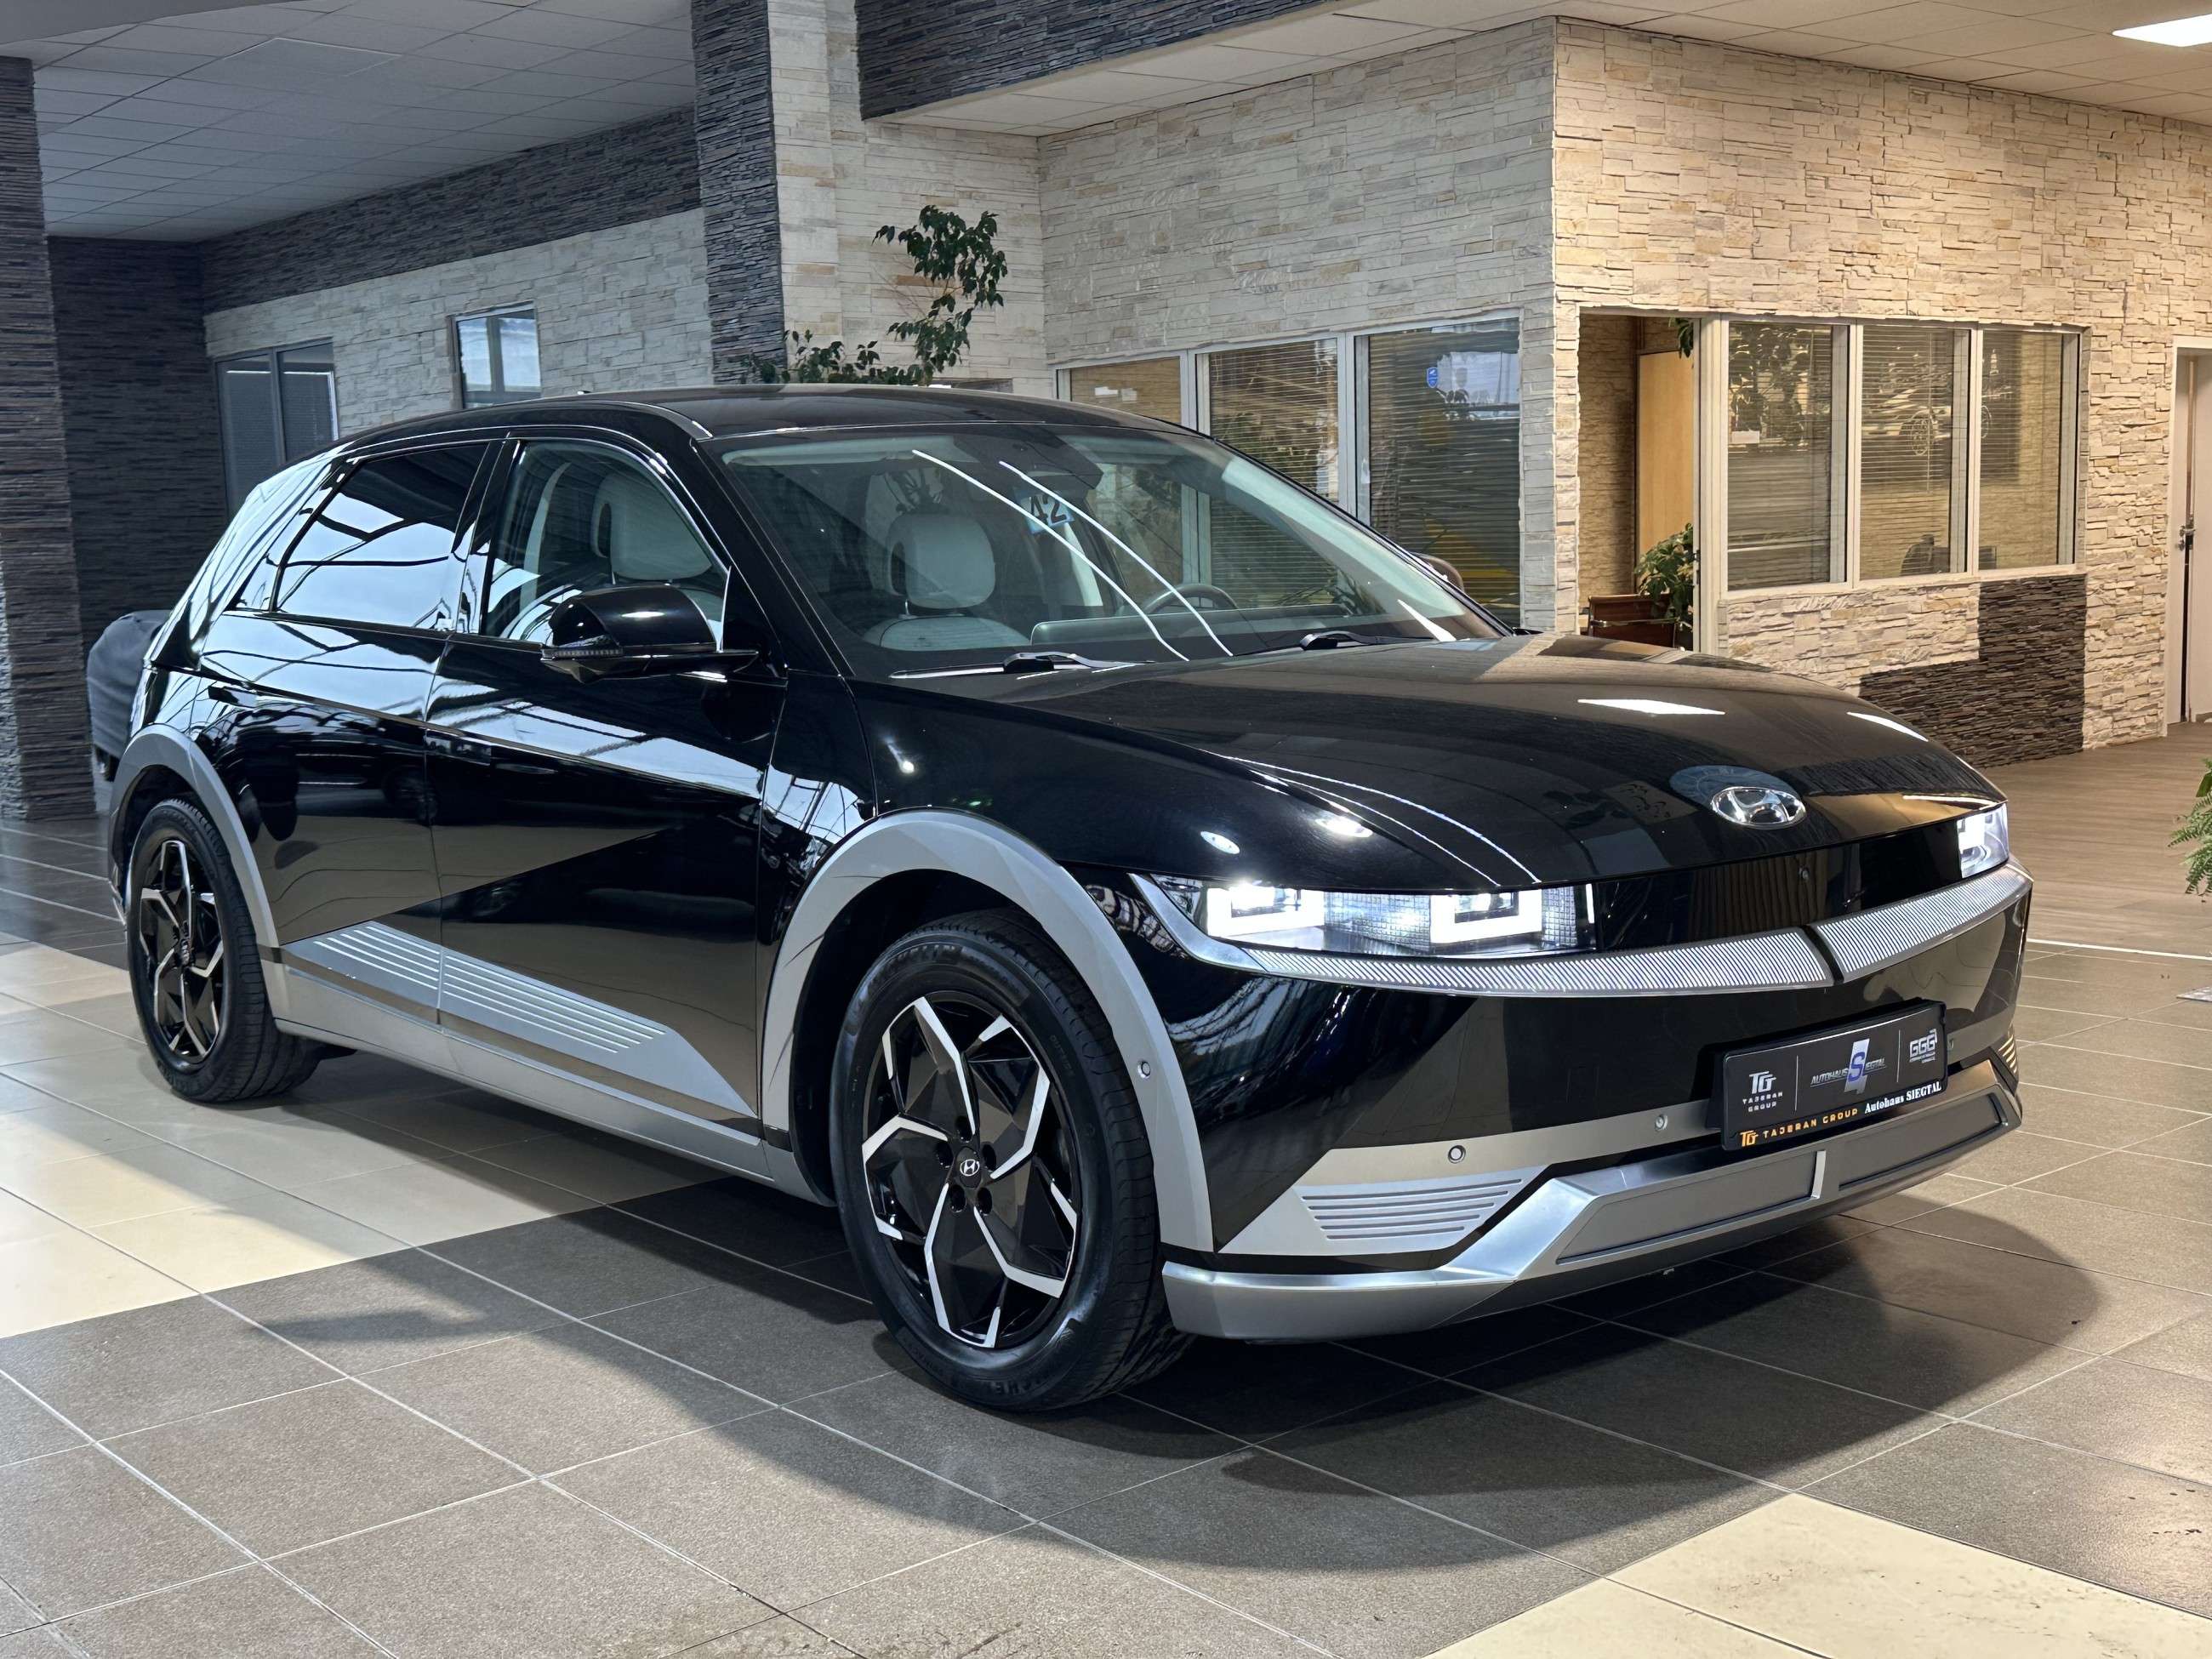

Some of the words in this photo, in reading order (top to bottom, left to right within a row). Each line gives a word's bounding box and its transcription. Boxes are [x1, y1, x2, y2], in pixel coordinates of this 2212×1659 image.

[1909, 1035, 1936, 1058] GGG
[1748, 1070, 1777, 1095] TG
[1810, 1067, 1850, 1086] AUTOHAUS
[1742, 1092, 1783, 1104] TAJERAN
[1747, 1101, 1777, 1113] GROUP
[1763, 1119, 1817, 1138] TAJERAN
[1822, 1108, 1858, 1124] GROUP
[1864, 1095, 1905, 1115] Autohaus
[1906, 1080, 1942, 1102] SIEGTAL
